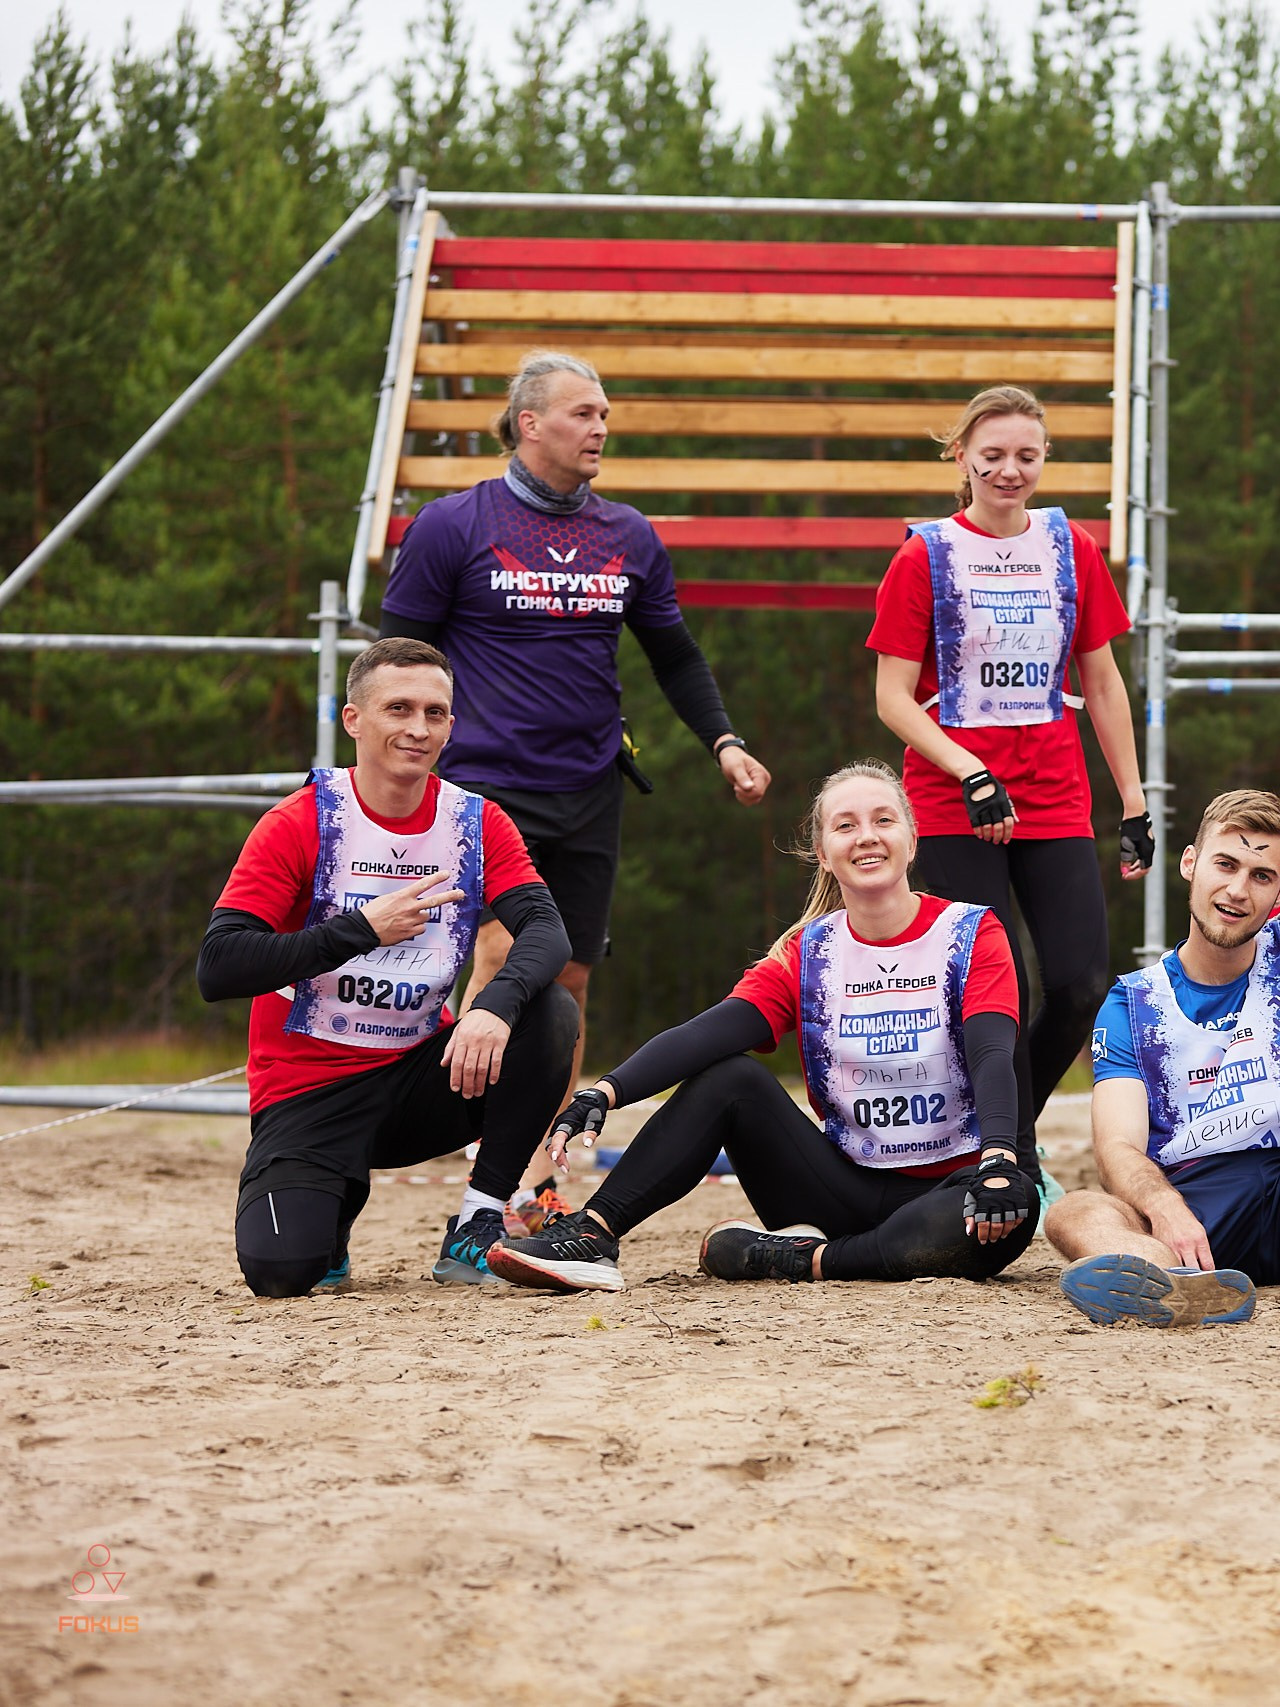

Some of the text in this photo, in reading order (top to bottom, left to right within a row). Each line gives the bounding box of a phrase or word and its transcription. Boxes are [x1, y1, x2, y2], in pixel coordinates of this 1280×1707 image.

[968, 564, 1042, 573] ГОНКА ГЕРОЕВ
[490, 570, 630, 595] ИНСТРУКТОР
[505, 595, 624, 614] ГОНКА ГЕРОЕВ
[971, 589, 1050, 609] КОМАНДНЫЙ
[995, 608, 1032, 623] СТАРТ
[980, 662, 1050, 687] 03209
[351, 861, 393, 875] ГОНКА
[337, 974, 431, 1012] 03203
[845, 975, 937, 994] ГОНКА ГЕРОЕВ
[841, 1005, 940, 1035] КОМАНДНЫЙ
[355, 1022, 420, 1038] ГАЗПРОМБАНК
[869, 1034, 915, 1054] СТАРТ
[853, 1093, 948, 1129] 03202
[880, 1136, 952, 1155] ГАЗПРОМБАНК
